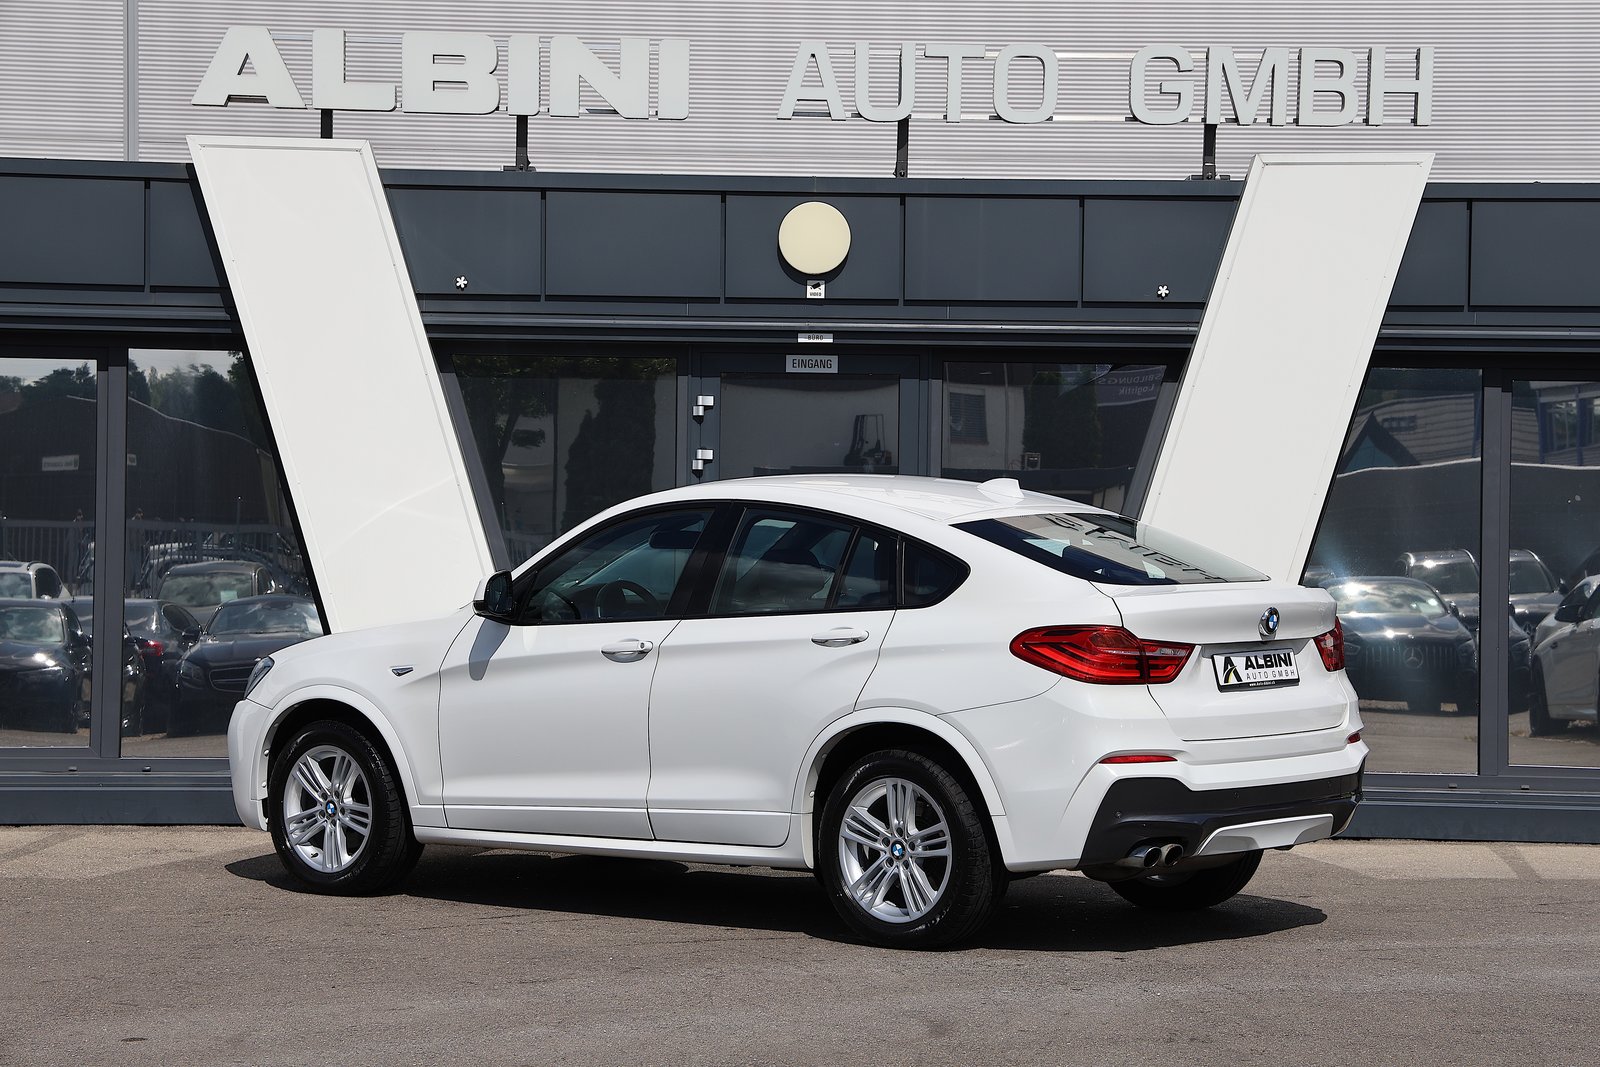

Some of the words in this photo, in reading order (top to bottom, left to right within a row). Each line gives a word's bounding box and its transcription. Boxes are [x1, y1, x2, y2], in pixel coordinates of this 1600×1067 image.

[191, 26, 690, 120] ALBINI
[777, 40, 1060, 123] AUTO
[1128, 44, 1435, 127] GMBH
[792, 358, 833, 369] EINGANG
[1245, 653, 1292, 670] ALBINI
[1247, 671, 1268, 680] AUTO
[1272, 669, 1295, 678] GMBH
